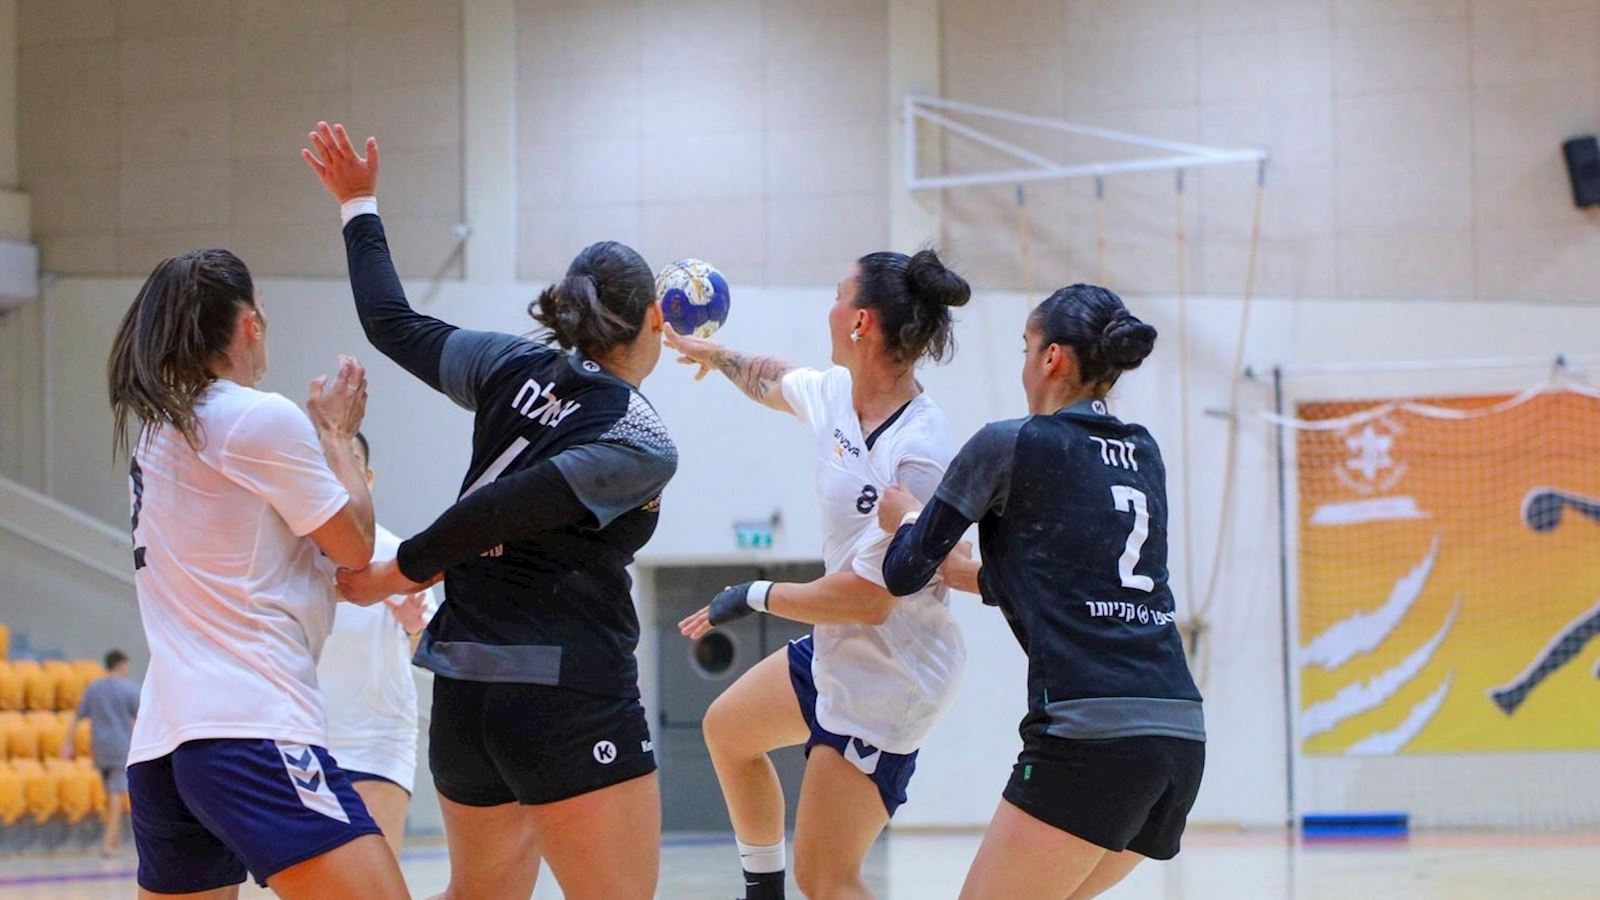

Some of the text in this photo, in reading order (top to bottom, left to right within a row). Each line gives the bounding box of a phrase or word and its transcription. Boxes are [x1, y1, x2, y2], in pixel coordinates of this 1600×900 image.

[1088, 435, 1138, 472] זהר
[856, 484, 878, 514] 8
[1110, 485, 1155, 593] 2
